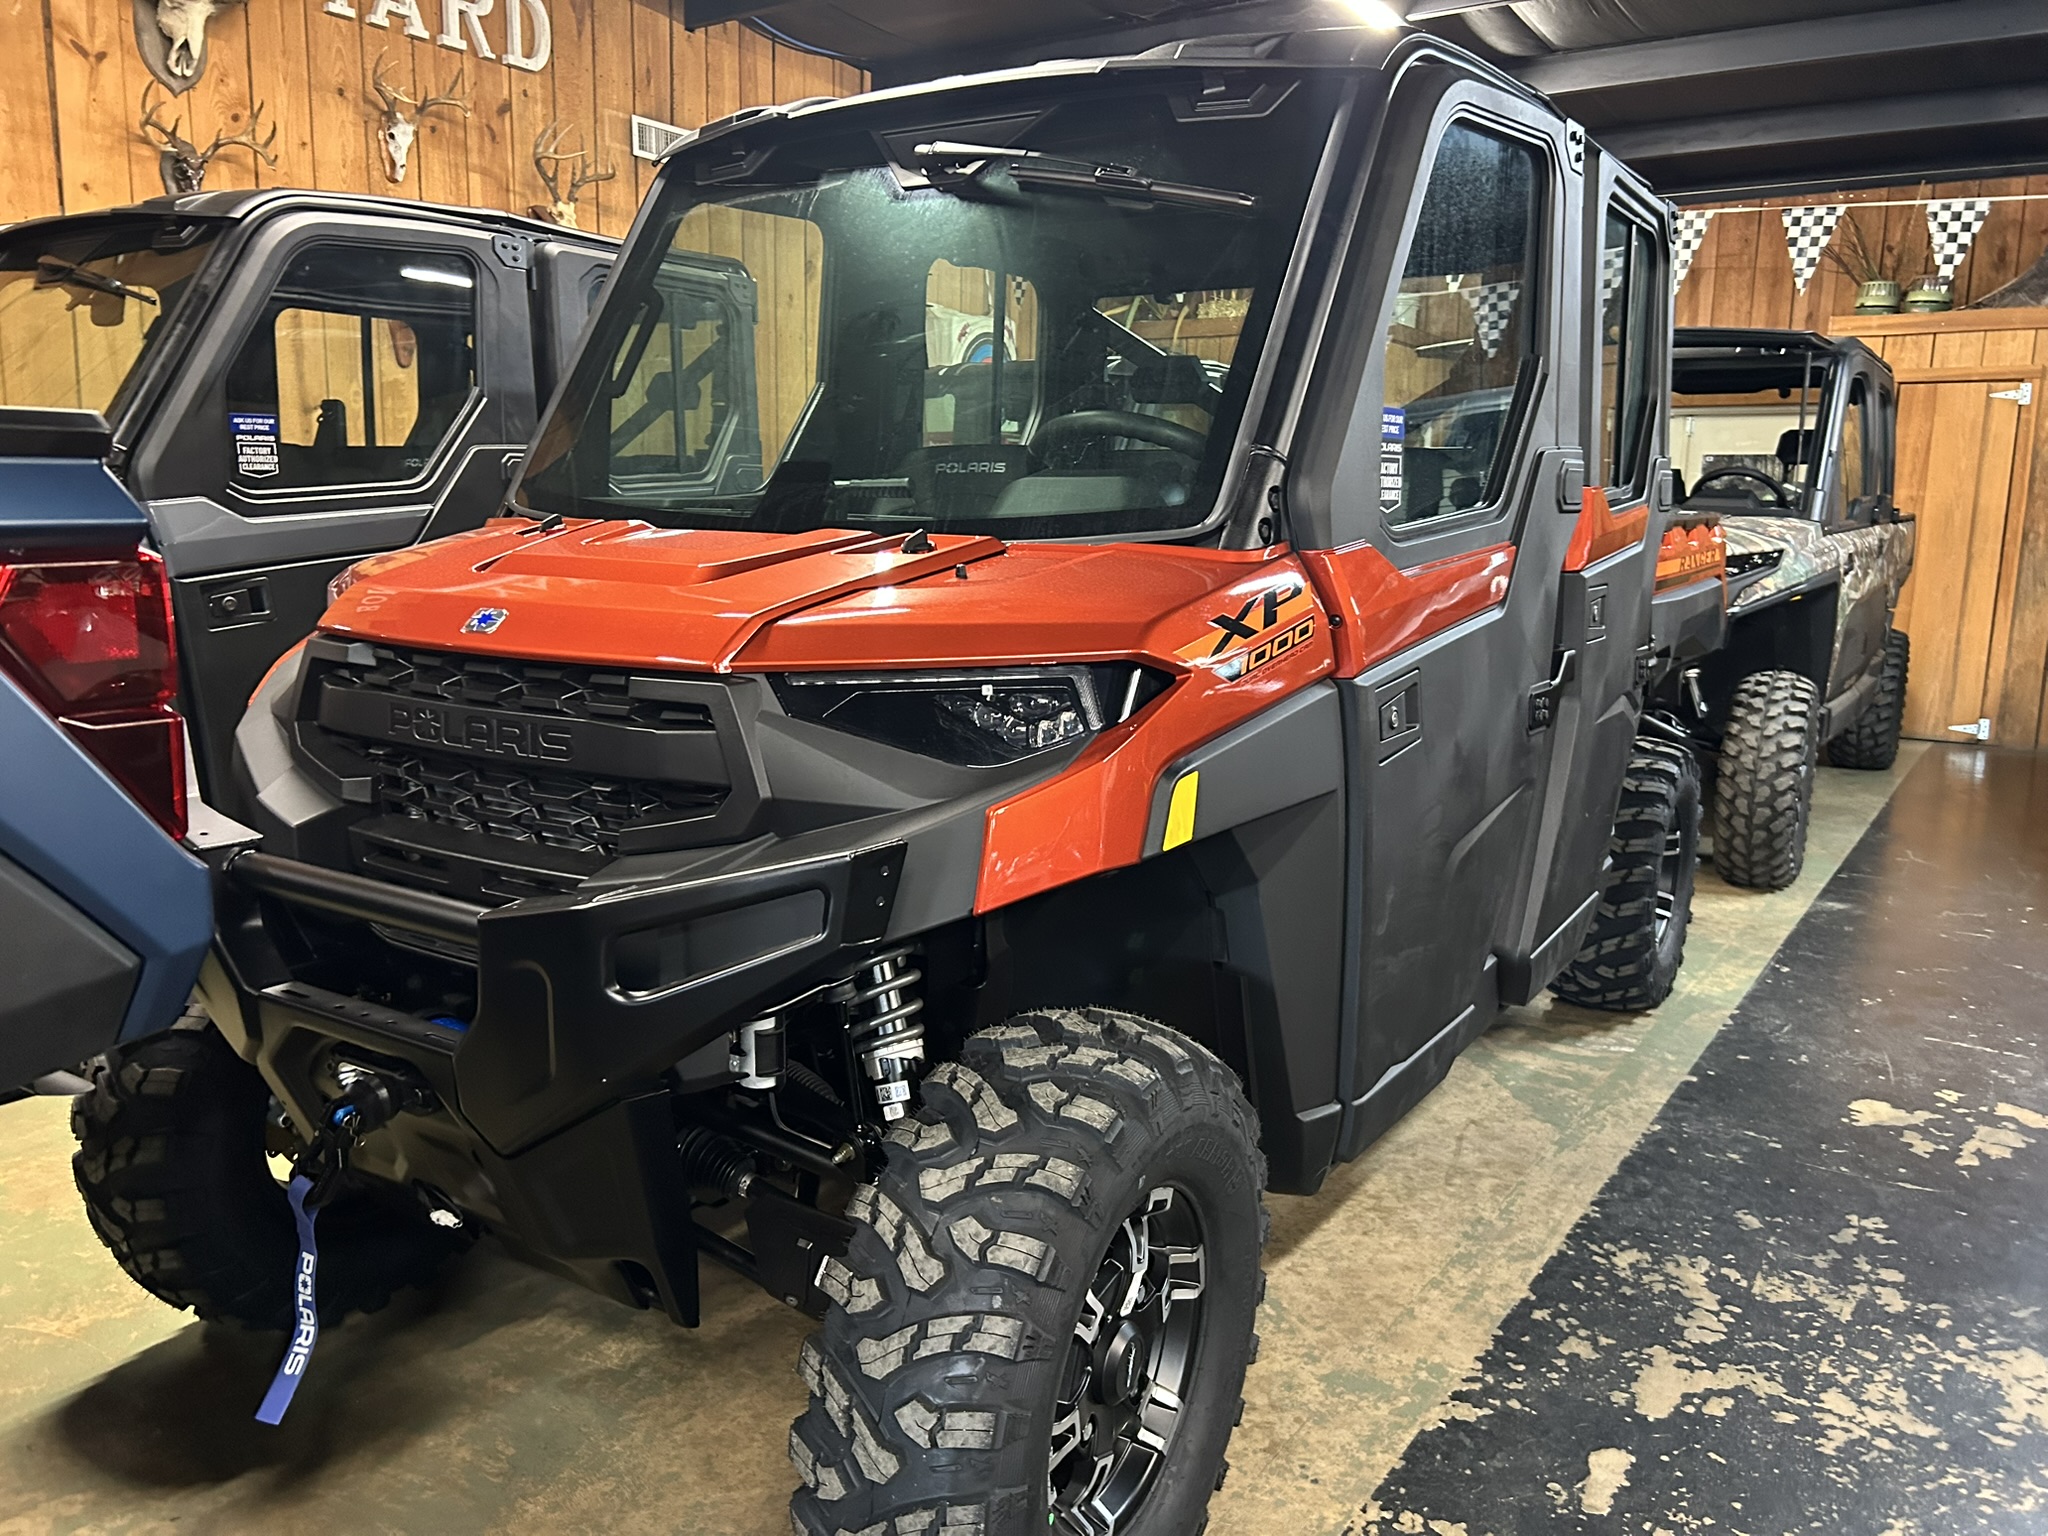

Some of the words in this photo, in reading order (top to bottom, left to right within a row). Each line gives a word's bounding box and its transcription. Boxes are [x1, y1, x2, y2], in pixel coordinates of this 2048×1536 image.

[238, 455, 279, 463] AUTHORIZED
[242, 447, 271, 455] FACTORY
[242, 463, 276, 471] CLEARANCE
[935, 461, 1007, 474] POLARIS
[1679, 548, 1721, 572] RANGER
[1208, 582, 1304, 659] XP
[1239, 617, 1315, 676] 1000
[389, 701, 575, 763] POLARIS
[283, 1251, 316, 1376] POLARIS
